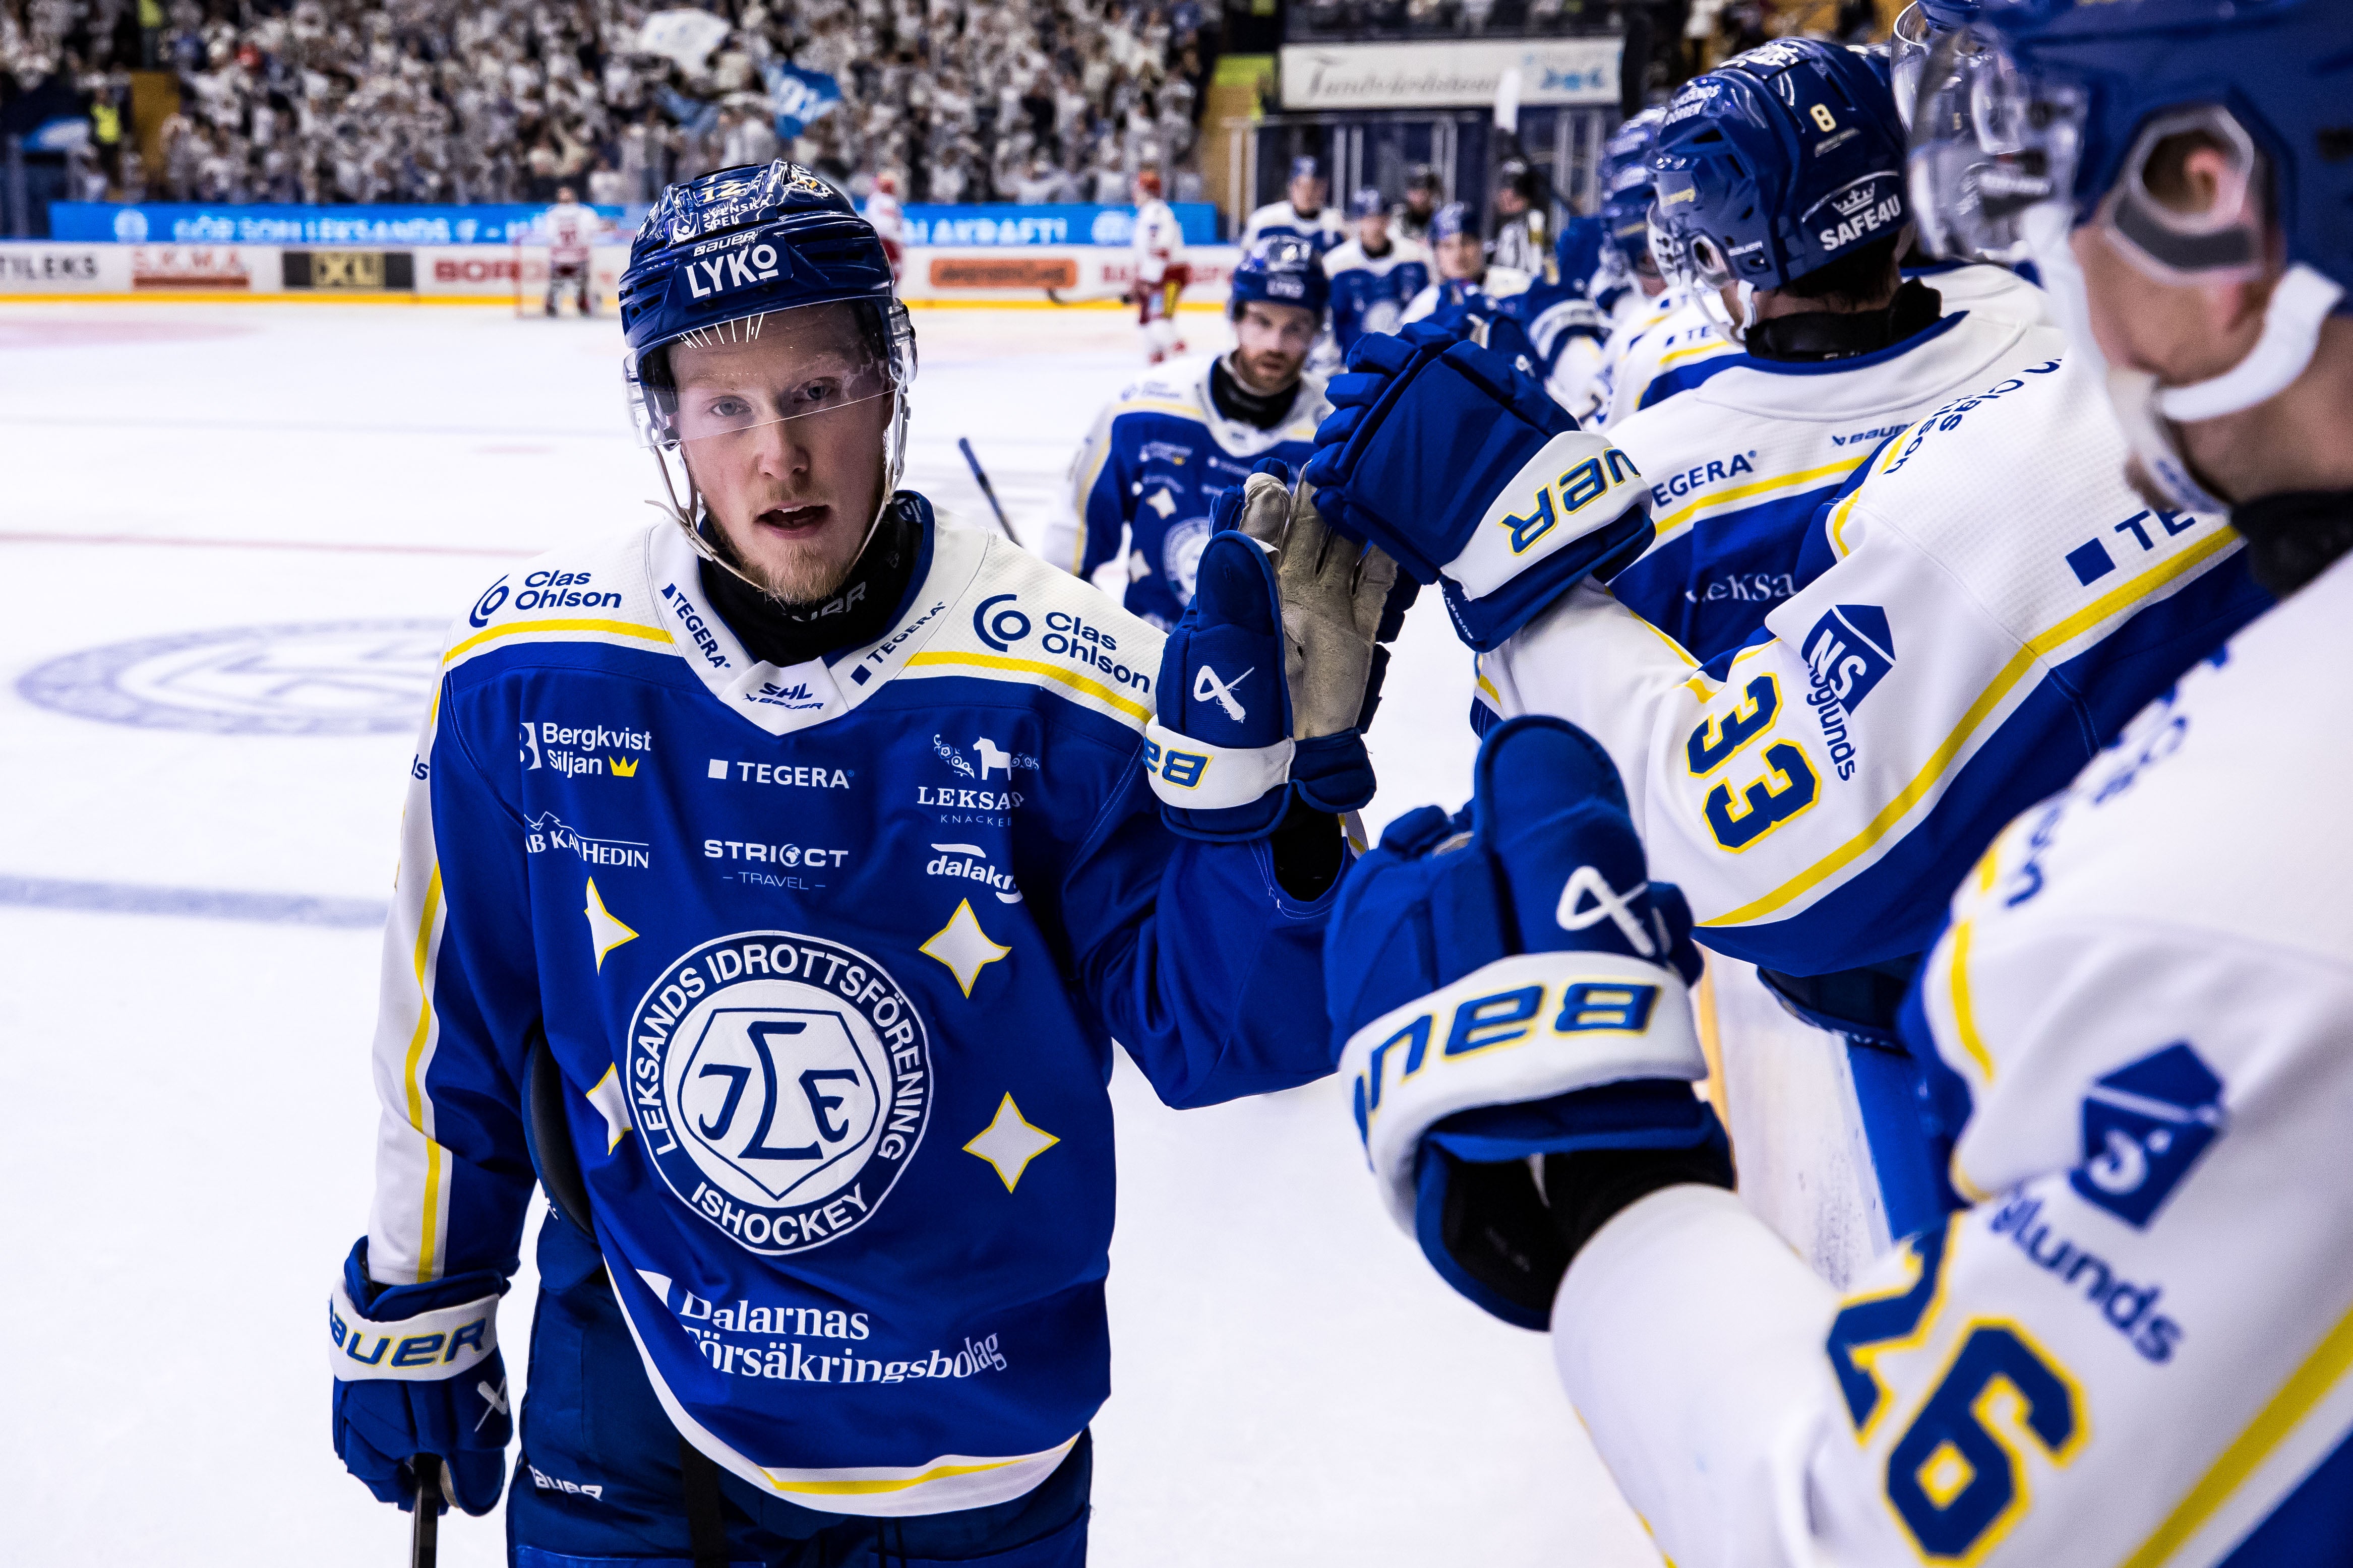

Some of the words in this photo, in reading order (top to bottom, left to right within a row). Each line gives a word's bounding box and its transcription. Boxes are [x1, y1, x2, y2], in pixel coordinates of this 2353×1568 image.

[1810, 103, 1837, 132] 8
[1819, 194, 1901, 251] SAFE4U
[694, 230, 758, 257] BAUER
[686, 244, 779, 298] LYKO
[524, 570, 591, 588] Clas
[515, 588, 622, 610] Ohlson
[1045, 611, 1117, 651] Clas
[1041, 633, 1151, 694] Ohlson
[759, 682, 814, 701] SHL
[542, 722, 652, 751] Bergkvist
[547, 748, 602, 778] Siljan
[1685, 672, 1823, 854] 33
[582, 842, 649, 869] HEDIN
[738, 871, 809, 890] TRAVEL
[926, 855, 1016, 890] dalakr
[636, 967, 705, 1155] LEKSANDS
[705, 944, 923, 1160] IDROTTSFÖRENING
[691, 1181, 869, 1246] ISHOCKEY
[679, 1289, 870, 1340] Dalarnas
